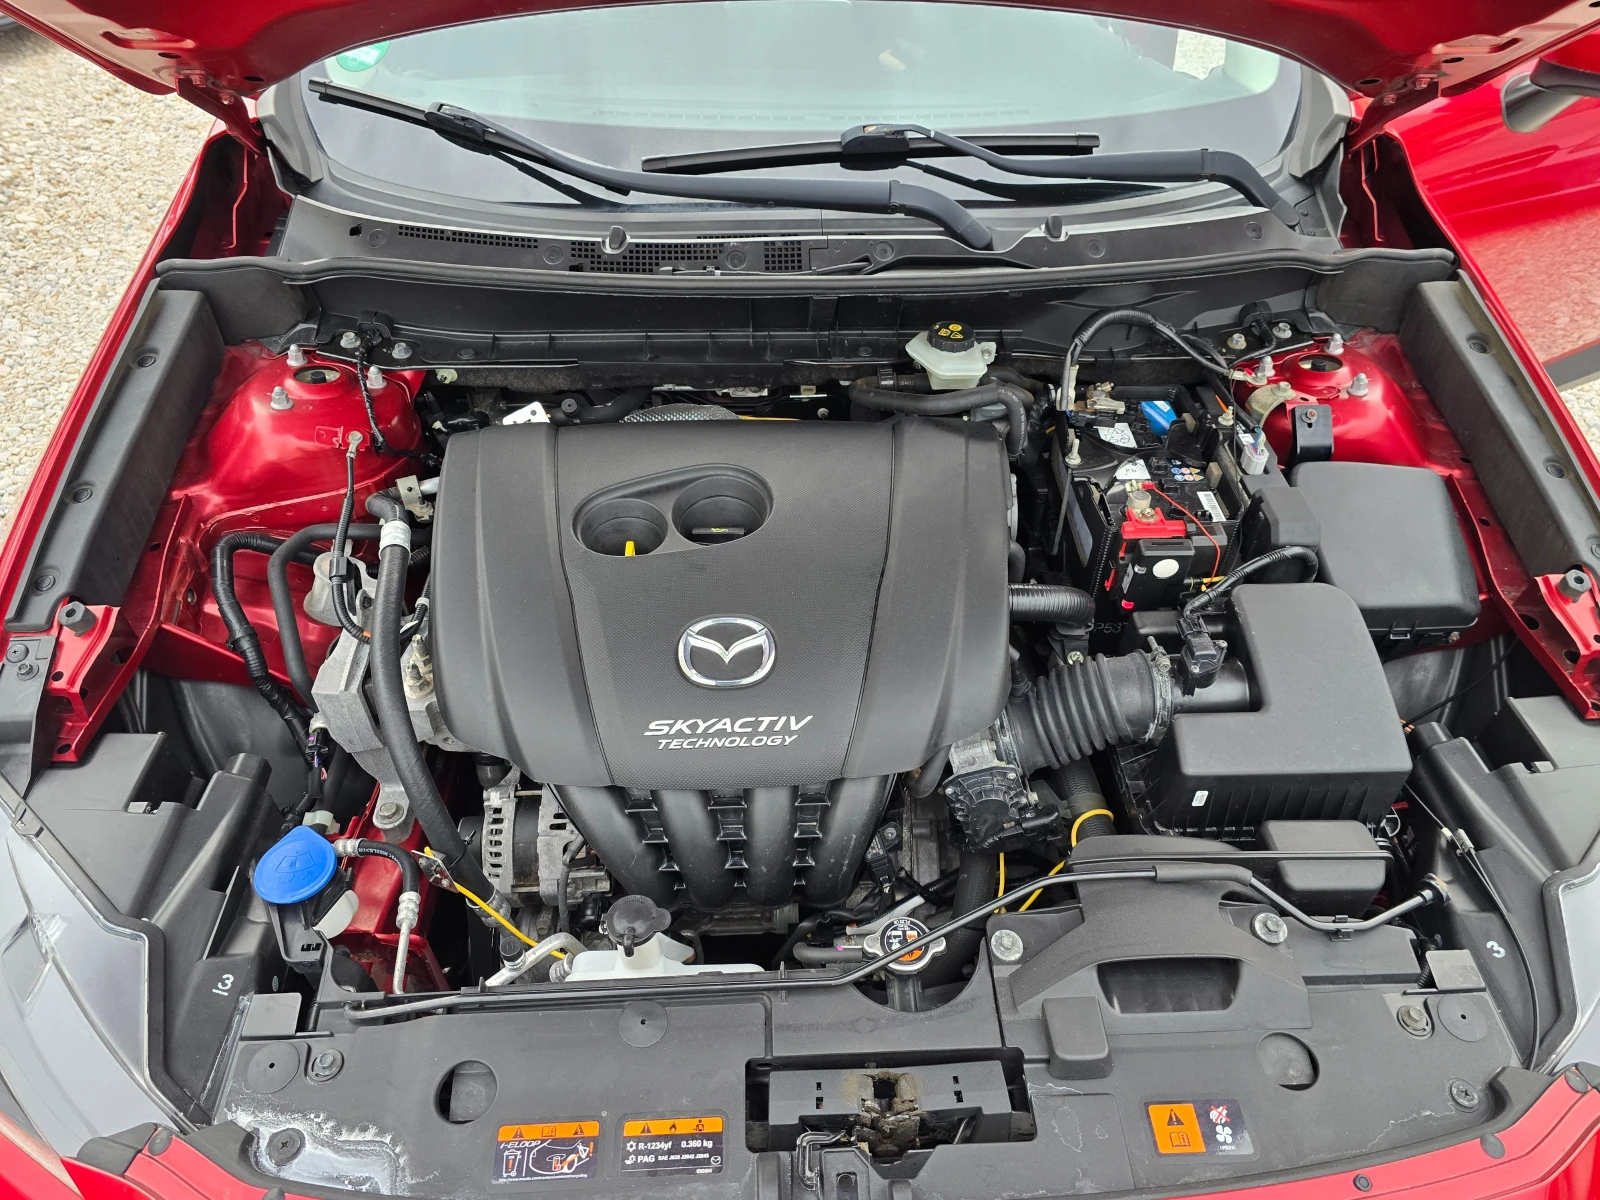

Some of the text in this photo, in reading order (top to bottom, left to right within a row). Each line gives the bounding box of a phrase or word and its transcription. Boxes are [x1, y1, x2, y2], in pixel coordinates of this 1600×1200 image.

[643, 715, 814, 736] SKYACTIV
[657, 735, 799, 750] TECHNOLOGY
[1485, 940, 1506, 958] 3
[638, 1140, 713, 1150] R-1234yf 0.360 kg
[638, 1154, 656, 1163] PAG
